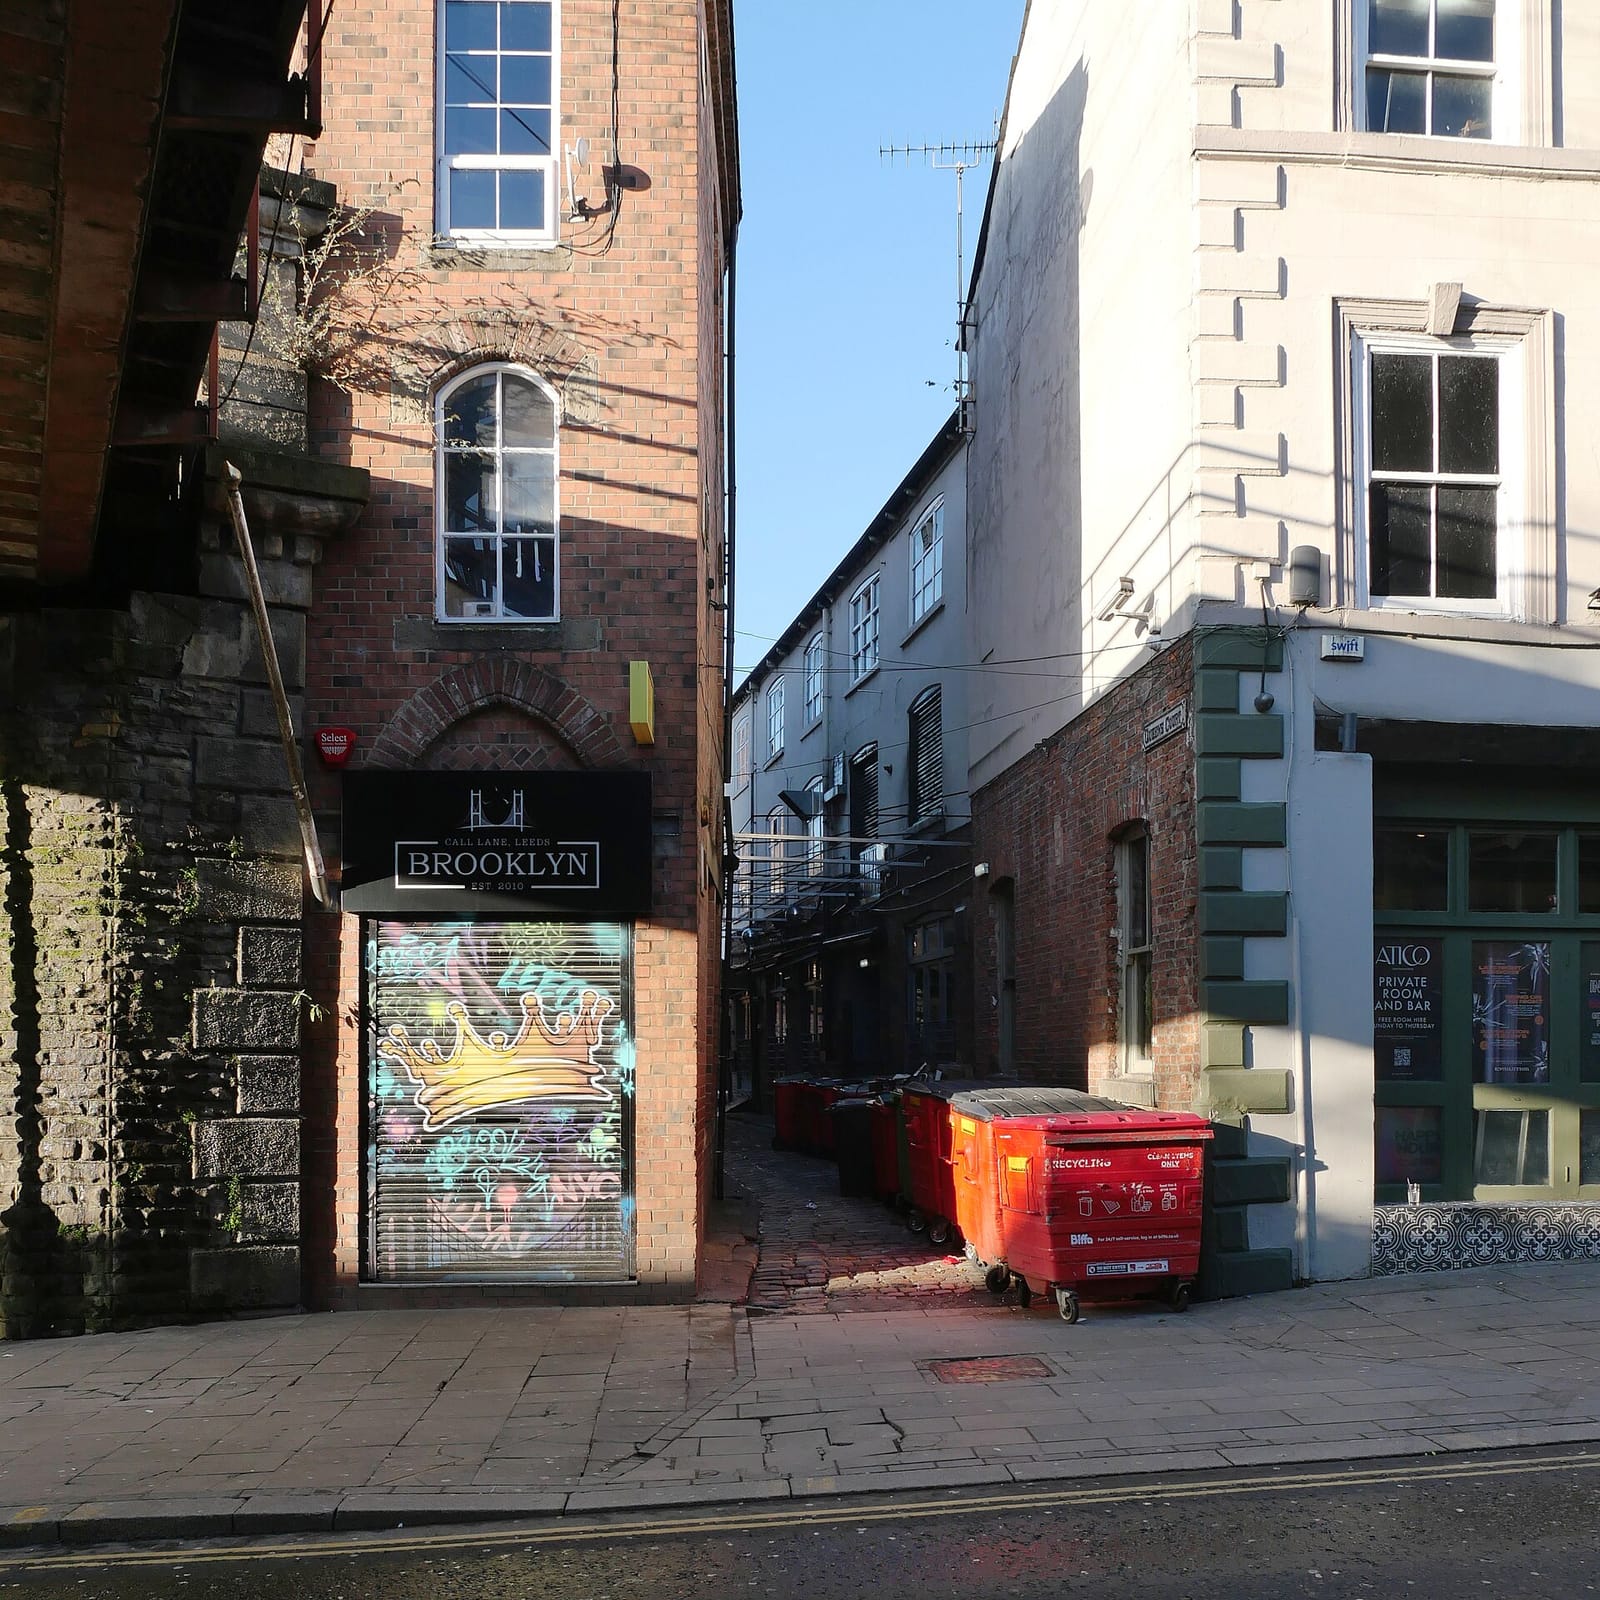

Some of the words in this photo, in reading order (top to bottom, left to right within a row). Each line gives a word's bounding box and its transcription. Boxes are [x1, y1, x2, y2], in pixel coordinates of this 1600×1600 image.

[1331, 638, 1359, 652] swift
[321, 732, 347, 742] Select
[445, 838, 474, 847] CALL
[477, 838, 511, 848] LANE,
[515, 838, 551, 847] LEEDS
[407, 852, 589, 876] BROOKLYN
[471, 882, 492, 891] EST
[498, 882, 525, 891] 2010
[1375, 944, 1431, 967] ATICO
[1379, 976, 1427, 988] PRIVATE
[1383, 988, 1423, 999] ROOM
[1375, 1000, 1403, 1011] AND
[1407, 1000, 1431, 1011] BAR
[1052, 1158, 1112, 1169] RECYCLING
[1070, 1234, 1093, 1245] Biffa
